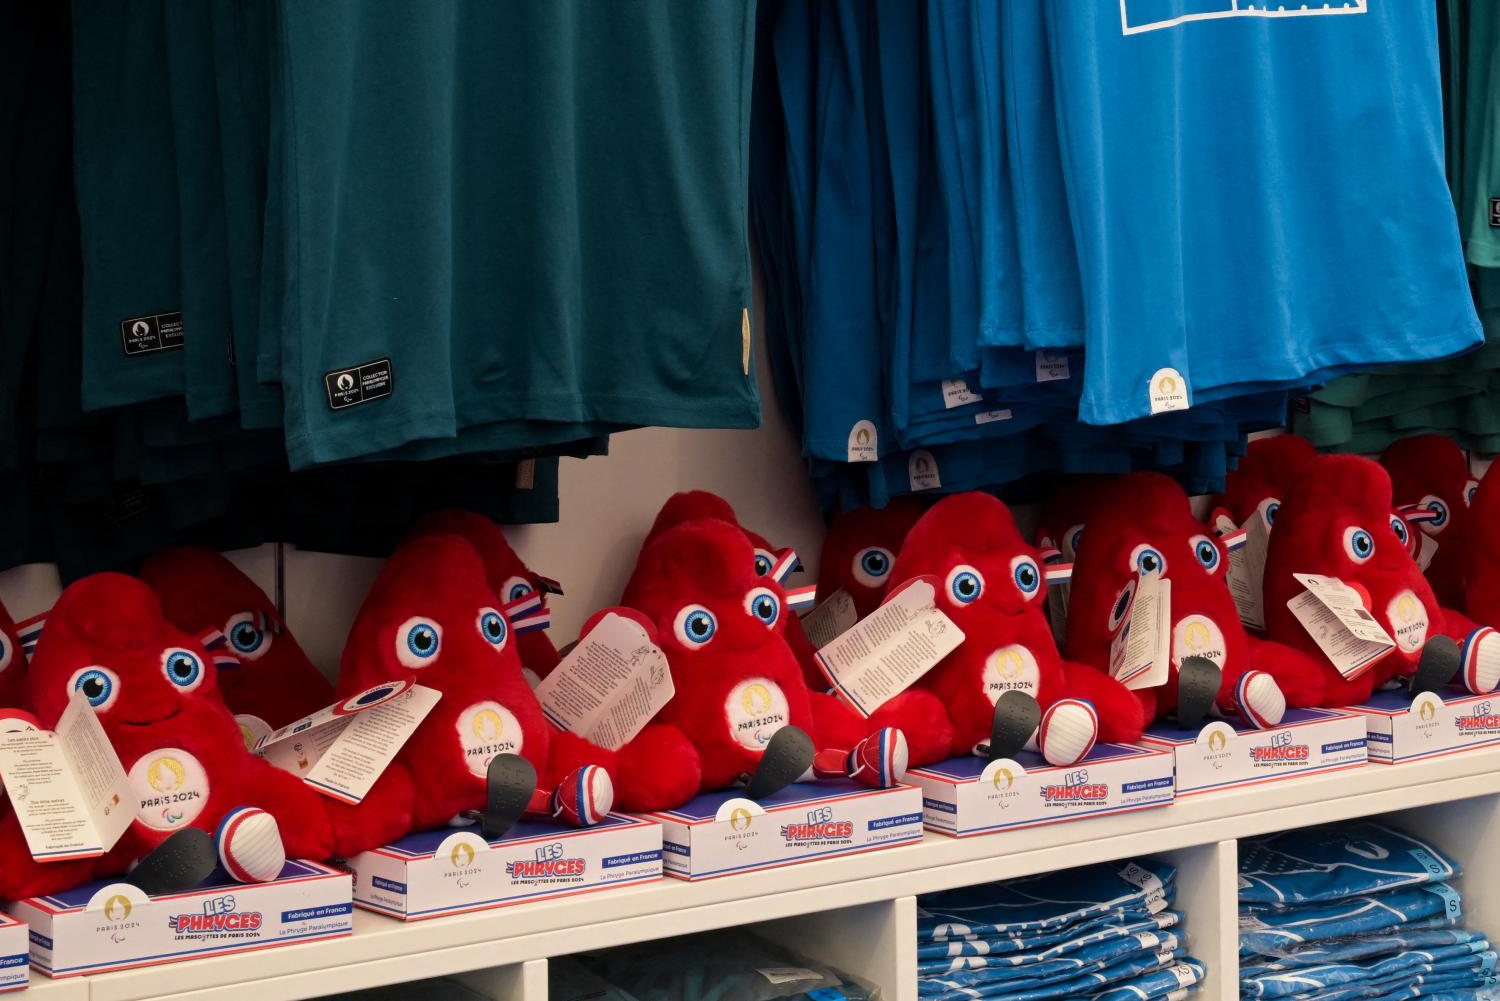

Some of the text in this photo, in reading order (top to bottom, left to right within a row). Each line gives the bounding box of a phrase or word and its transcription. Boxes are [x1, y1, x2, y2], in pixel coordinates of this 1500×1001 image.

[1013, 681, 1033, 689] 2024
[1473, 701, 1492, 717] LES
[763, 714, 783, 725] 2024
[494, 742, 514, 753] 2024
[1271, 731, 1293, 748] LES
[1253, 744, 1309, 761] PHRYGES
[1065, 768, 1089, 787] LES
[172, 790, 201, 803] 2024
[1045, 783, 1109, 801] PHRYGES
[807, 806, 833, 826] LES
[873, 820, 895, 829] Fabriqué
[902, 815, 920, 823] France
[785, 821, 853, 841] PHRYGES
[535, 842, 563, 860] LES
[607, 857, 630, 867] Fabriqué
[639, 852, 659, 861] France
[511, 857, 586, 879] PHRYGES
[202, 894, 236, 917] LES
[287, 909, 315, 920] Fabriqué
[324, 905, 347, 915] France
[1449, 900, 1457, 912] S
[119, 921, 140, 930] 2024
[175, 912, 263, 933] PHRYGES
